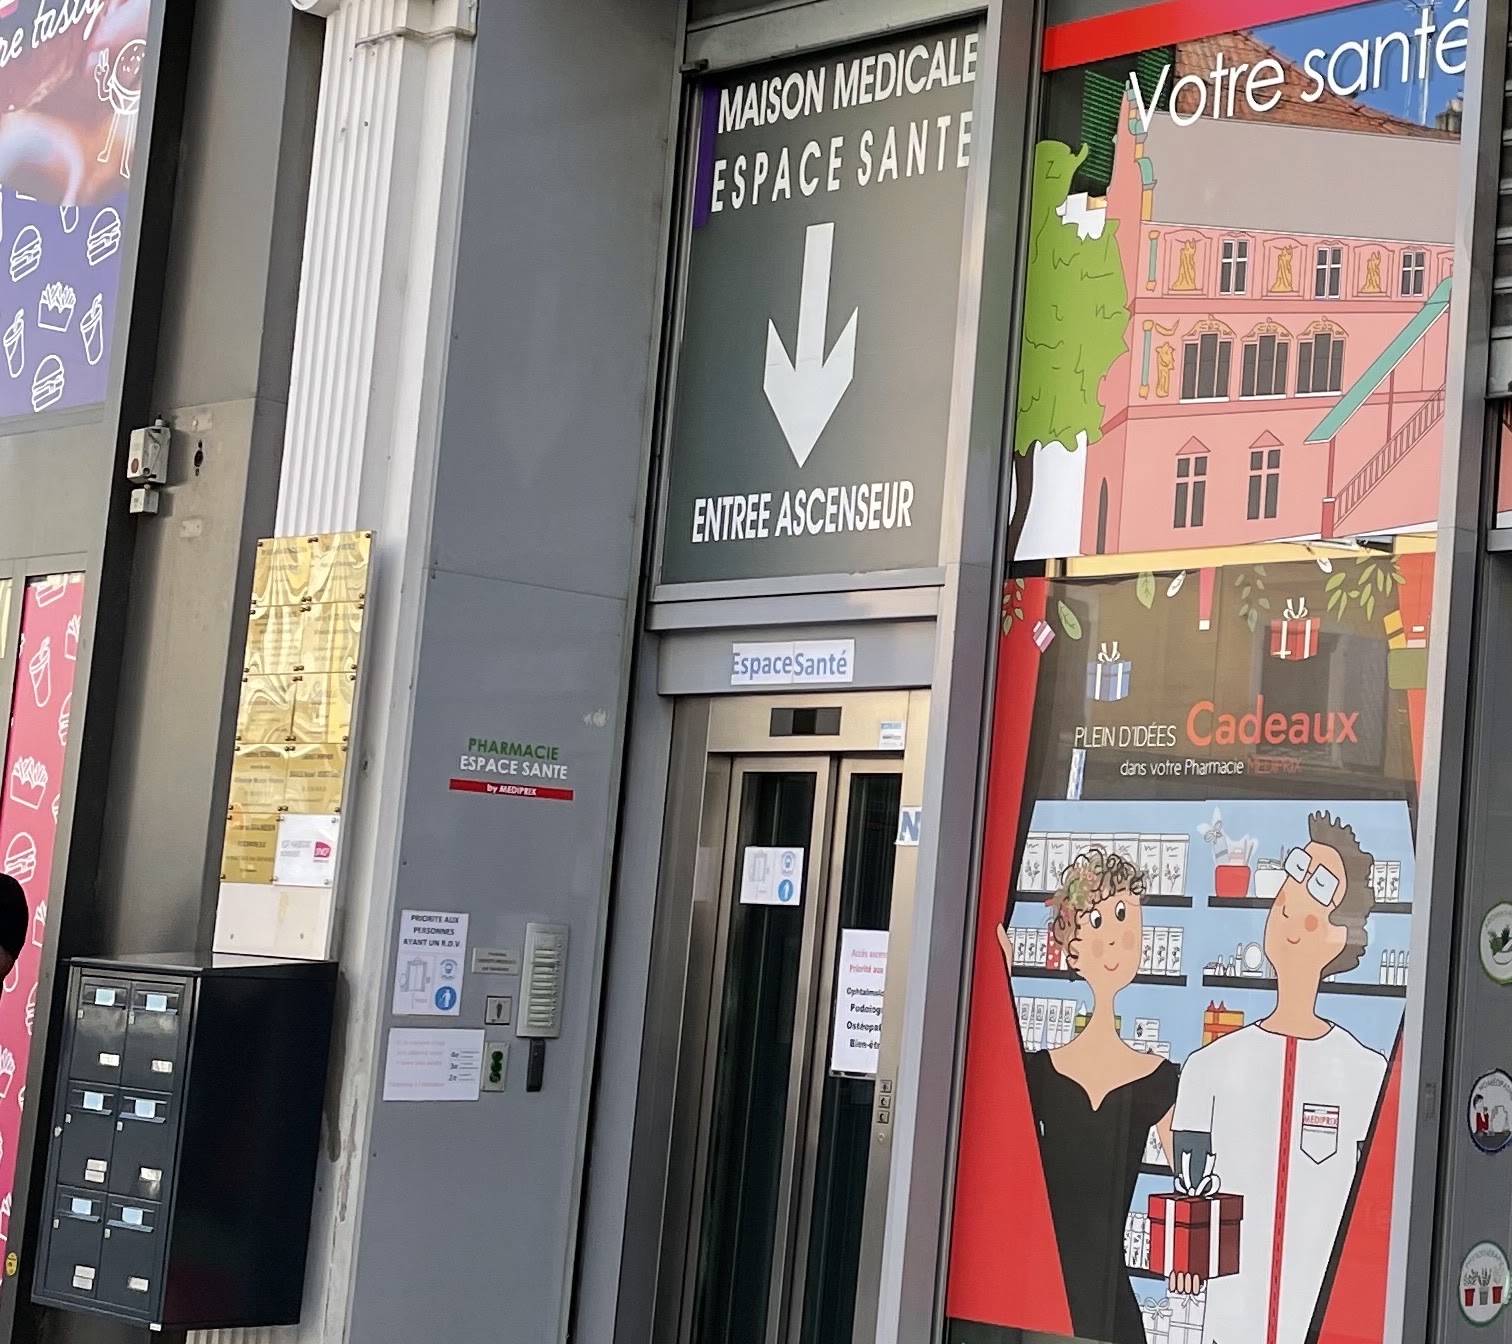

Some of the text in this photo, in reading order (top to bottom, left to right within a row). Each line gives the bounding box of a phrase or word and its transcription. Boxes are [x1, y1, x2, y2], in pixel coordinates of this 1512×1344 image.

[718, 33, 978, 134] MAISON MEDICALE
[1130, 52, 1286, 133] Votre
[711, 110, 973, 212] ESPACE SANTE
[692, 480, 915, 543] ENTREE ASCENSEUR
[1074, 694, 1360, 748] PLEIN D'IDÉES Cadeaux
[468, 737, 559, 761] PHARMACIE
[460, 755, 568, 780] ESPACE SANTE
[1120, 760, 1147, 775] dans
[1150, 762, 1181, 776] votre
[1184, 757, 1244, 776] Pharmacie
[486, 783, 498, 796] by
[413, 927, 455, 936] PERSONNES
[444, 916, 459, 924] AUX
